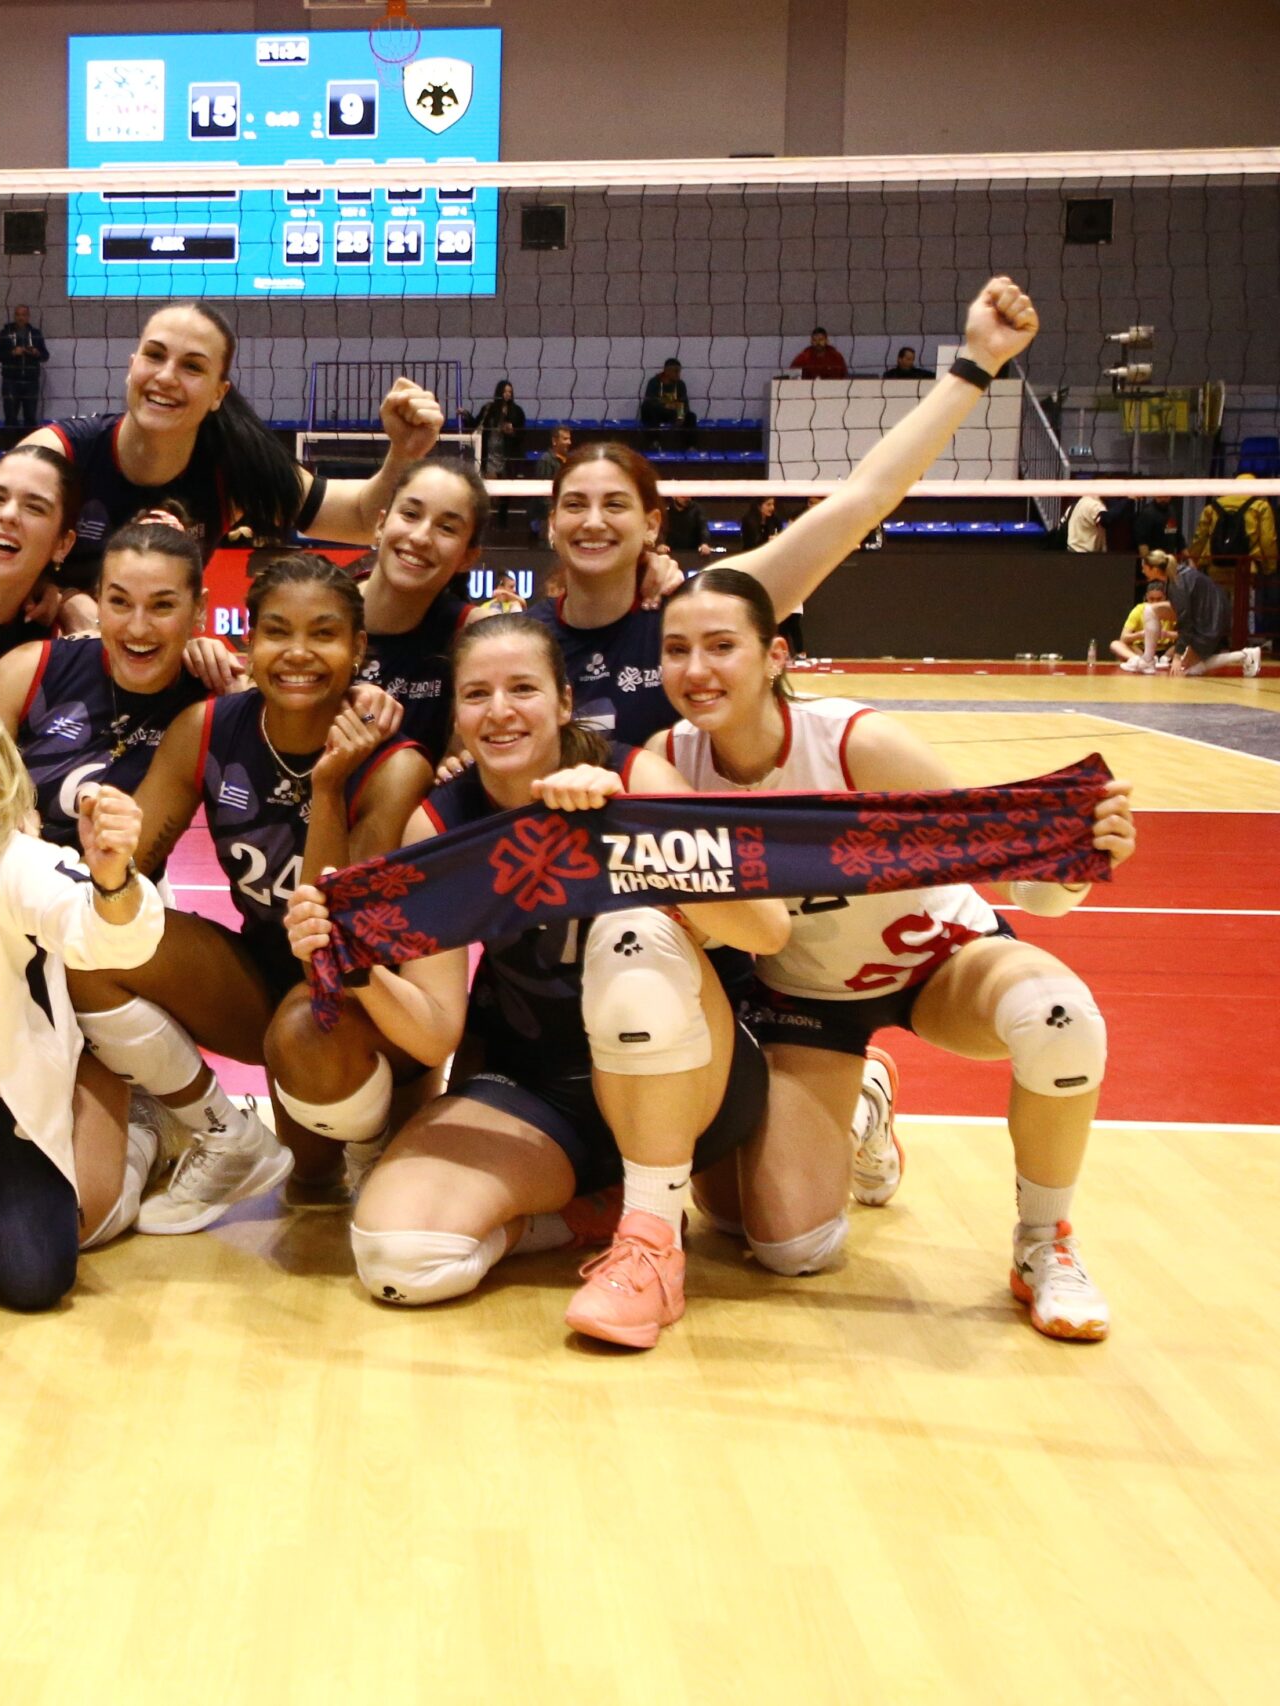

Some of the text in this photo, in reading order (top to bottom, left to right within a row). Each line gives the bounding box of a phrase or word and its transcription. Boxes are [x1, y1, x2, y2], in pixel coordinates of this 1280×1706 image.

[192, 96, 237, 127] 15
[340, 93, 364, 126] 9
[287, 231, 319, 254] 25
[337, 230, 369, 253] 25
[388, 230, 417, 253] 21
[439, 230, 471, 253] 20
[214, 607, 250, 635] BL
[736, 826, 769, 890] 1962
[230, 842, 305, 907] 24
[609, 869, 736, 895] ΚΗΦΙΣΙΑΣ
